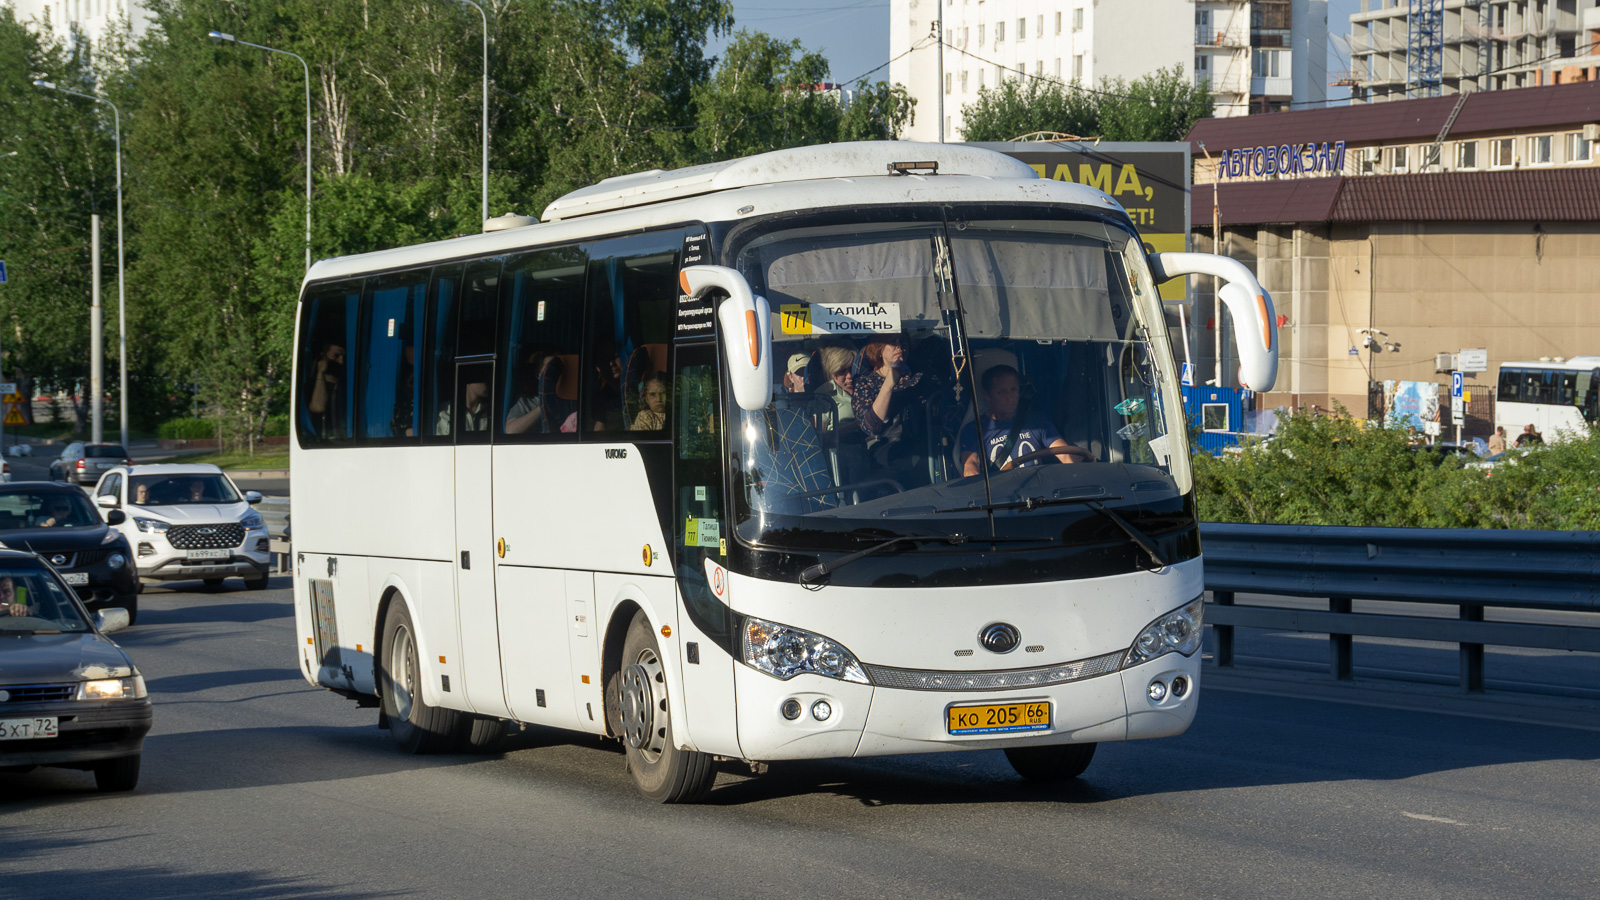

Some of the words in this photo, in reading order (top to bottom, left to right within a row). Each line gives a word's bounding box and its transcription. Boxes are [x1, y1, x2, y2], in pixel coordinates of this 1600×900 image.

[1218, 140, 1346, 178] АВТОВОКЗАЛ
[825, 306, 888, 316] ТАЛИЦА
[784, 310, 808, 329] 777
[825, 321, 893, 330] ТЮМЕНЬ
[1019, 431, 1031, 440] THE
[604, 448, 628, 459] YUTONG
[687, 531, 696, 541] 777
[958, 713, 979, 727] КО
[986, 707, 1018, 725] 205
[1026, 704, 1044, 717] 66
[36, 719, 52, 731] 72
